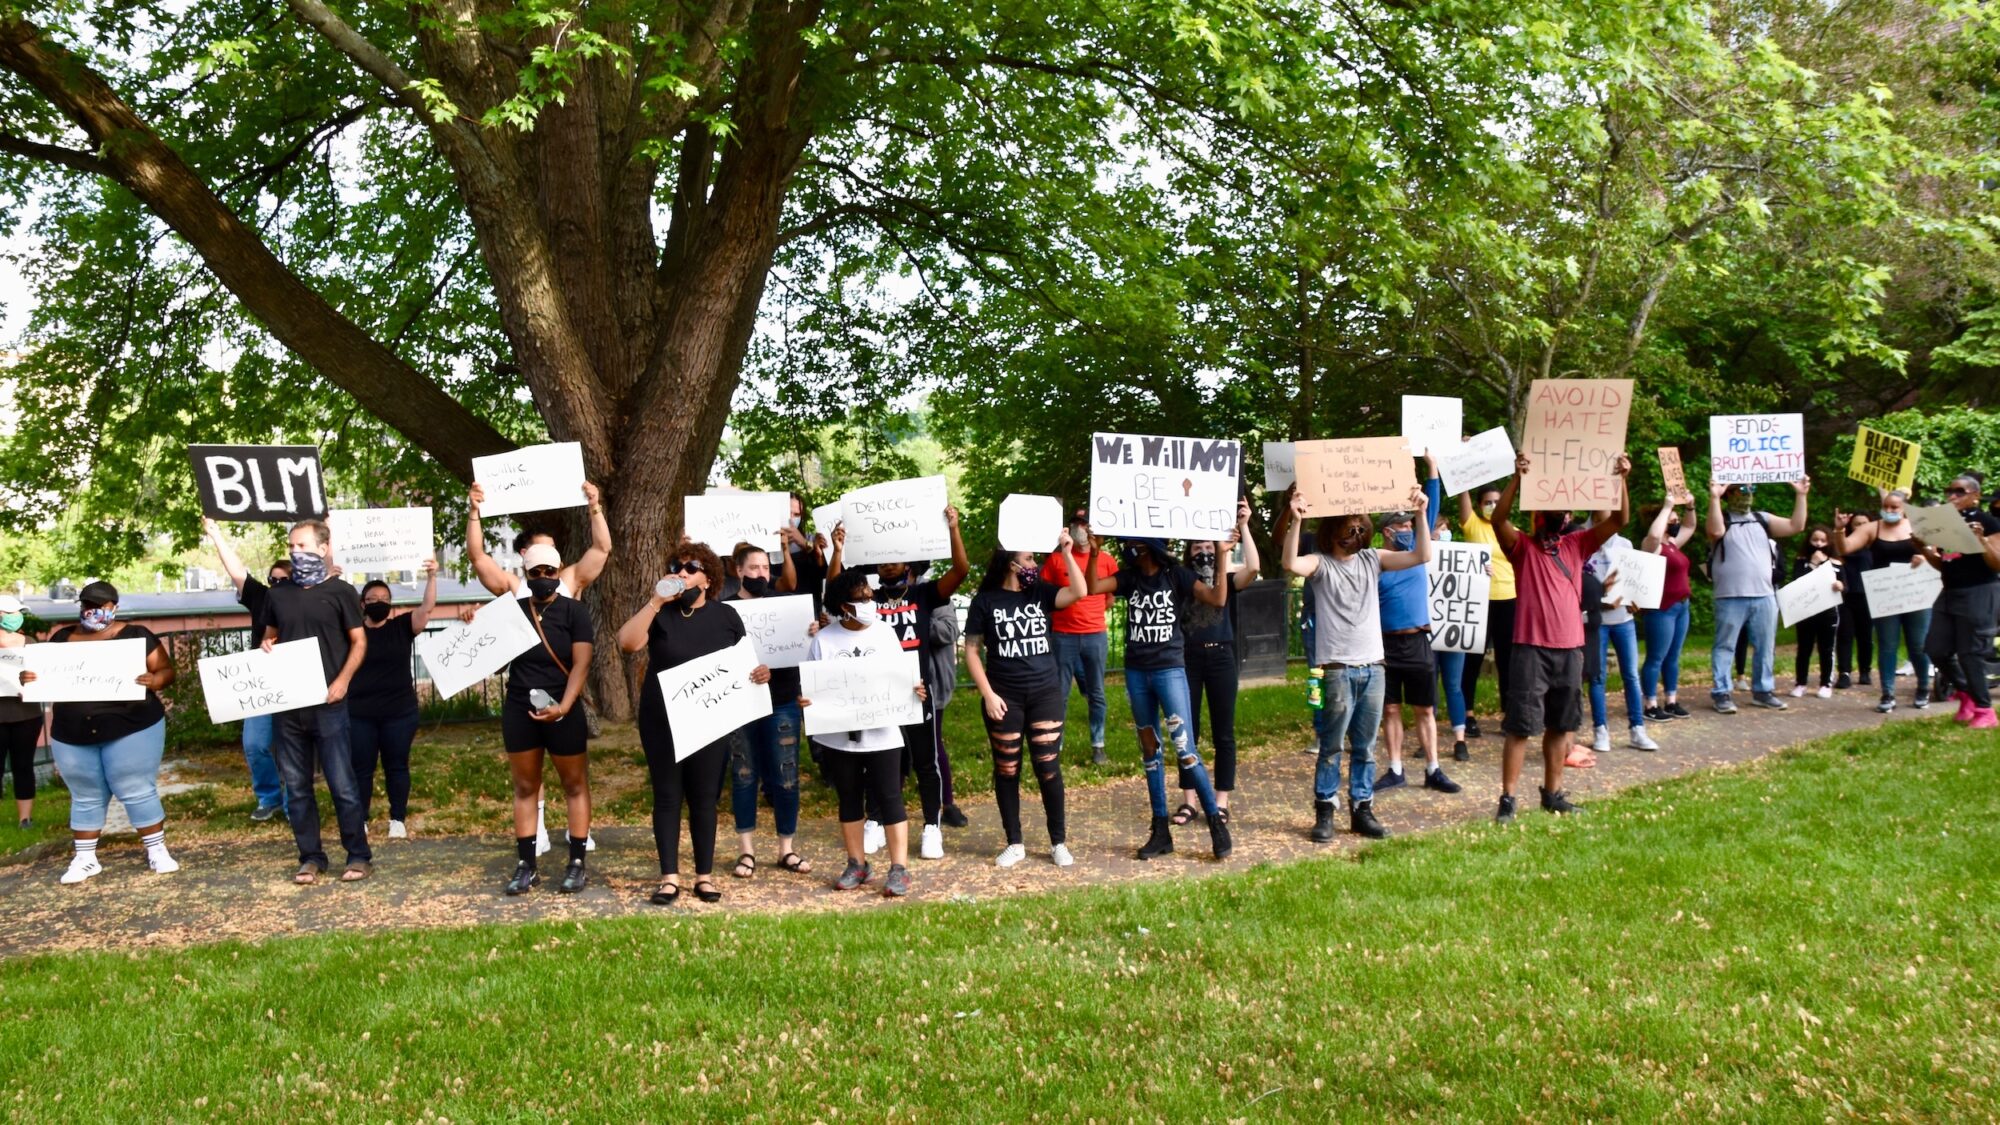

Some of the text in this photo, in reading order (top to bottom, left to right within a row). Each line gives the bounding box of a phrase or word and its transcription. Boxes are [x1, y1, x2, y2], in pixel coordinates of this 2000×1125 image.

[1536, 385, 1621, 408] AVOID
[1544, 410, 1614, 435] HATE
[1531, 436, 1617, 474] 4-FLOY
[1729, 436, 1792, 453] POLICE
[1865, 430, 1910, 460] BLACK
[1712, 454, 1804, 472] BRUTALITY
[1869, 450, 1898, 472] LIVES
[205, 456, 324, 514] BLM
[1863, 463, 1898, 485] MATTER
[1134, 473, 1169, 501] BE
[1535, 477, 1622, 506] SAKE!
[865, 517, 918, 534] Brown
[1438, 549, 1490, 574] HEAR
[1429, 573, 1471, 601] YOU
[1129, 590, 1174, 609] BLACK
[993, 601, 1045, 624] BLACK
[1432, 599, 1480, 625] SEE
[1130, 624, 1173, 642] MATTER
[1428, 623, 1476, 650] YOU
[998, 636, 1049, 658] MATTER
[232, 675, 271, 692] ONE
[238, 691, 288, 711] MORE
